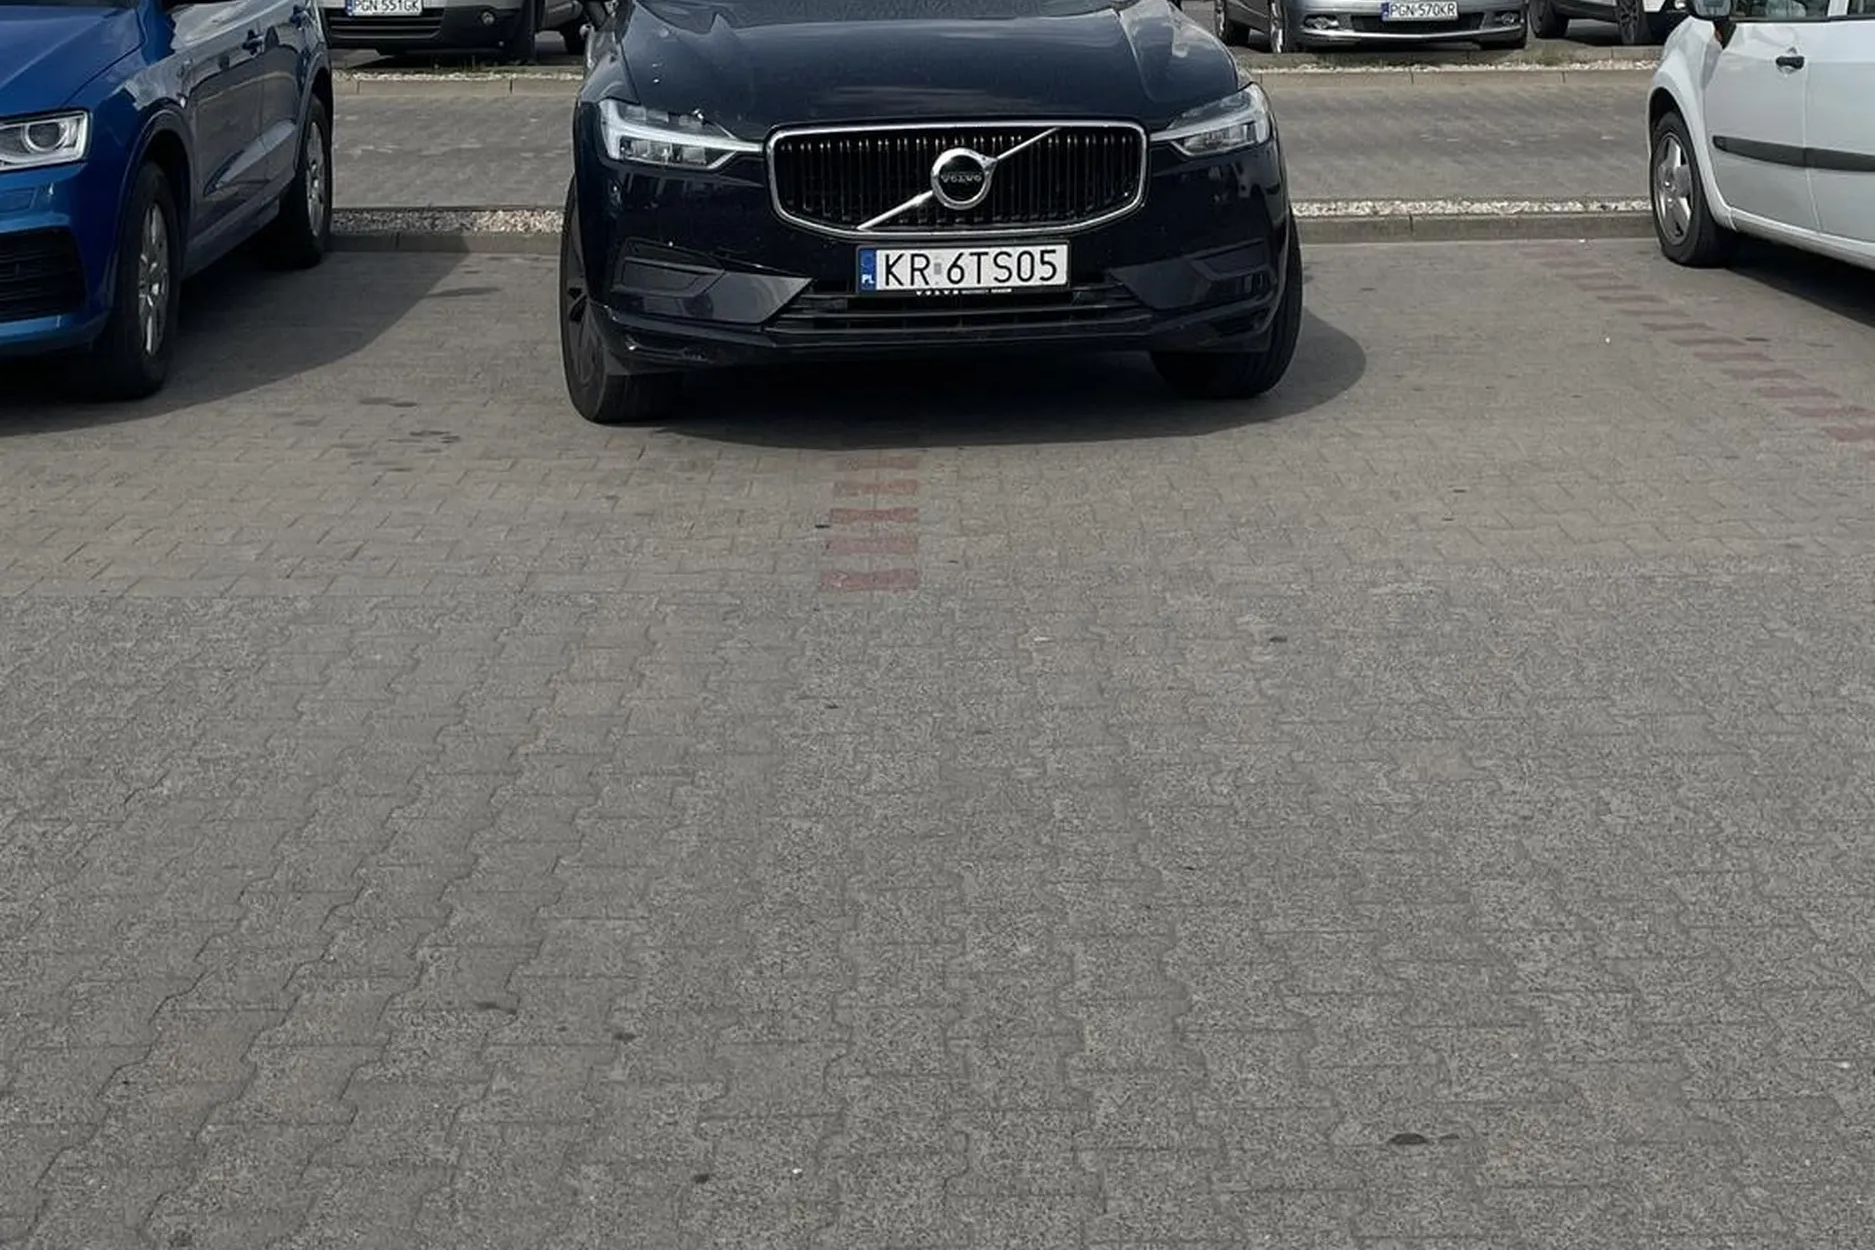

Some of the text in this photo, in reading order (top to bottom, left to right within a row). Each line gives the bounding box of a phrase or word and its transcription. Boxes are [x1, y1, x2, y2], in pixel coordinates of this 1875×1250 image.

[1390, 2, 1456, 17] PGN 570KR
[940, 172, 982, 183] VOLVO
[884, 249, 1058, 287] KR 6TS05
[861, 273, 875, 284] PL
